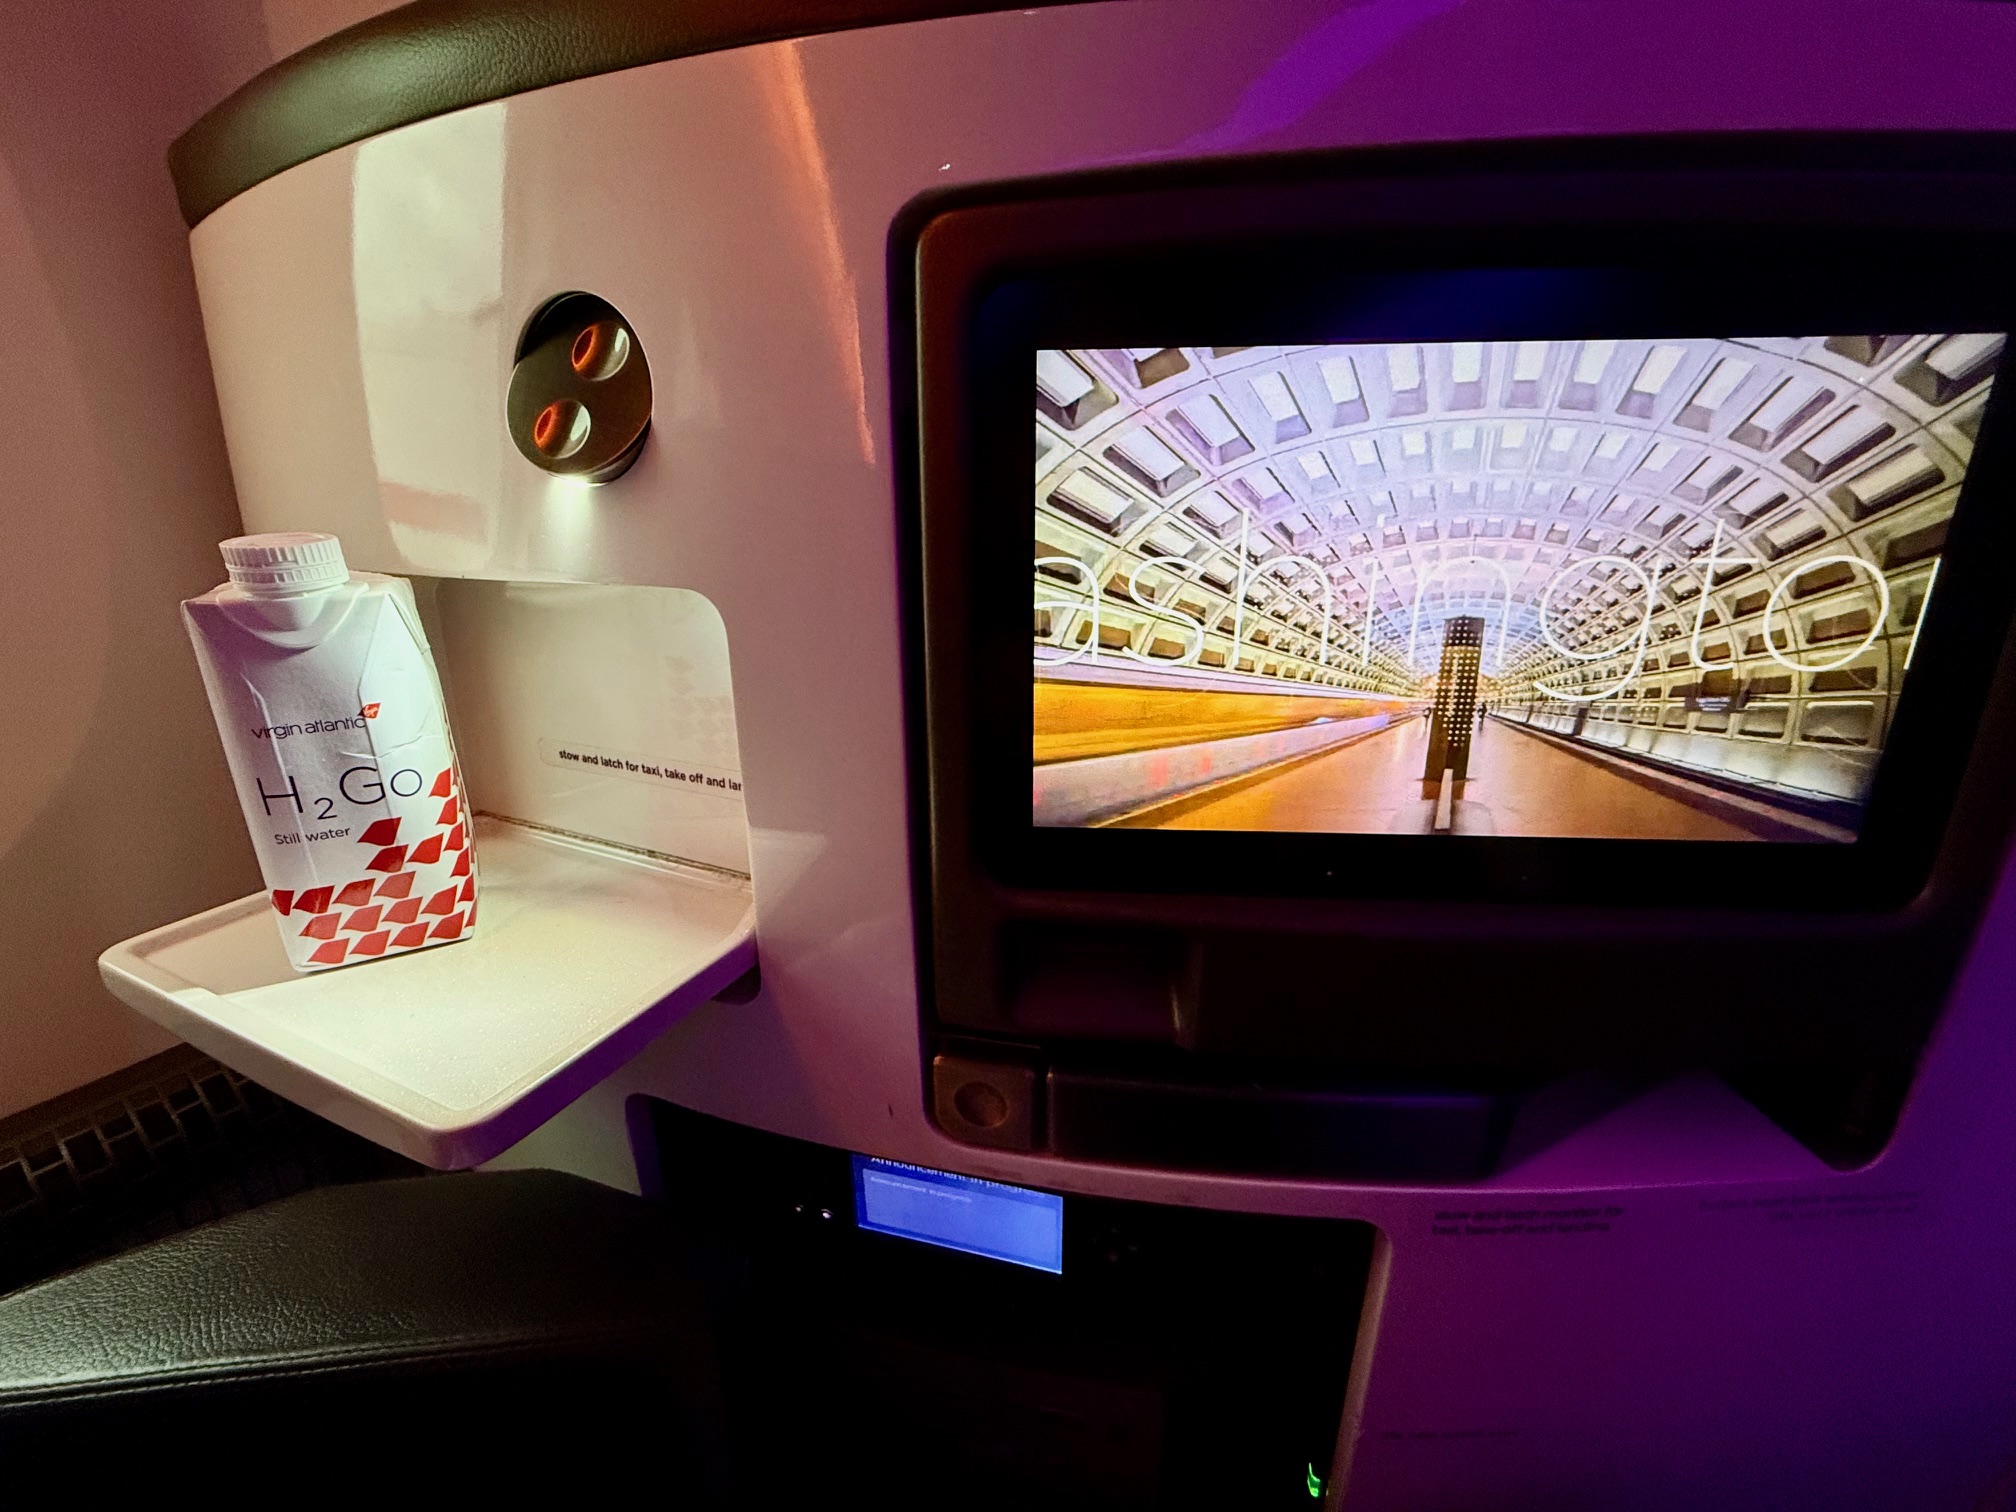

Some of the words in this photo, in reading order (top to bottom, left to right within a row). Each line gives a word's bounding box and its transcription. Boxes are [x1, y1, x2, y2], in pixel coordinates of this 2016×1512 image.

[1034, 507, 1942, 701] ashingto
[252, 722, 303, 740] virgin
[305, 716, 367, 734] atlantic
[559, 749, 580, 762] stow
[582, 755, 599, 766] and
[600, 756, 624, 770] latch
[625, 760, 640, 773] for
[641, 764, 663, 779] taxi,
[664, 768, 687, 782] take
[689, 773, 704, 785] off
[706, 777, 726, 789] and
[274, 832, 301, 845] Still
[305, 827, 351, 842] water
